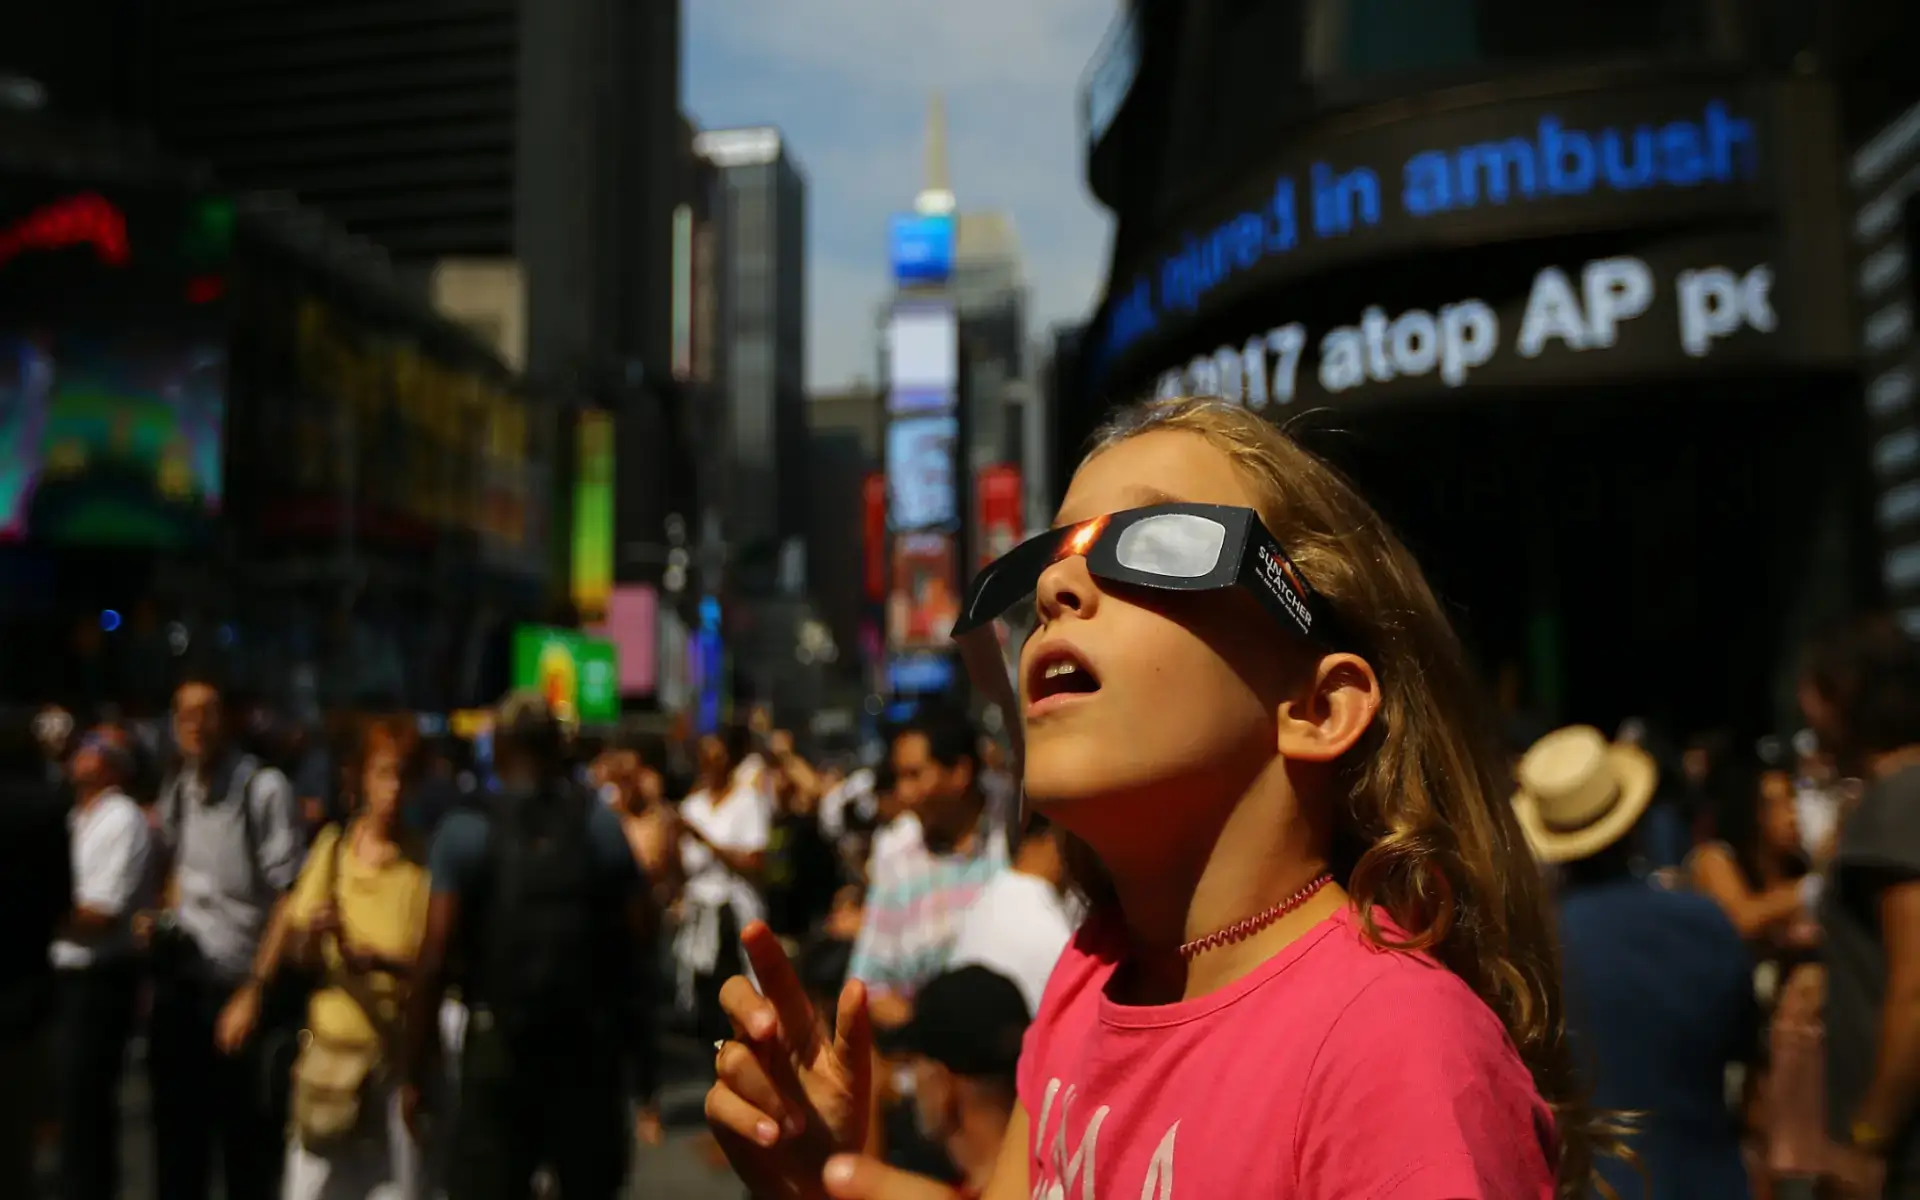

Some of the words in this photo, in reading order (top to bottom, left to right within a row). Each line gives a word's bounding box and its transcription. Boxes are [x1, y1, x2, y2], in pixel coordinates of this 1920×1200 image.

[1311, 162, 1382, 238] in
[1403, 98, 1756, 216] ambush
[1319, 303, 1499, 391] atop
[1516, 256, 1655, 358] AP
[1259, 546, 1283, 577] SUN
[1266, 566, 1313, 627] CATCHER
